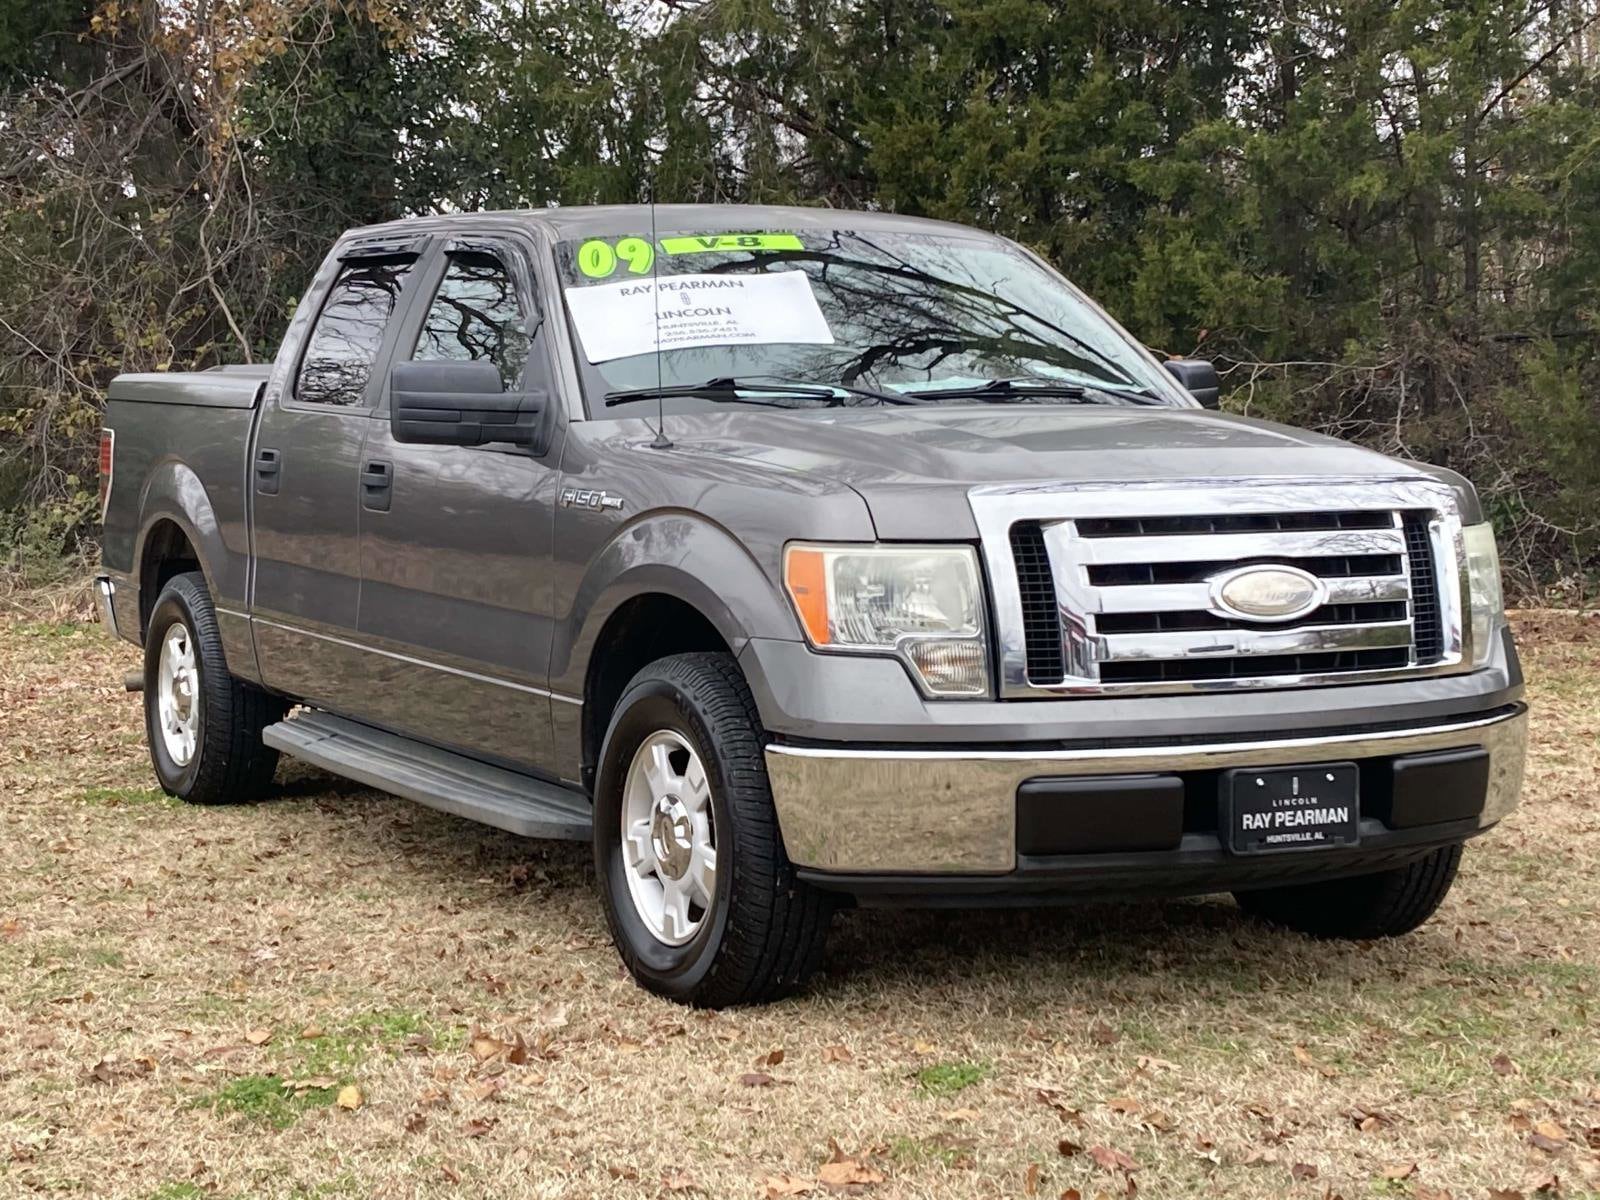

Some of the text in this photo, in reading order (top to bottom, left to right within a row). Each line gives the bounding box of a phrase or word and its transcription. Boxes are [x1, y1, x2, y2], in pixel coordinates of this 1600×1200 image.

[696, 237, 762, 249] V-8
[578, 237, 655, 279] 09
[620, 280, 745, 297] RAY PEARMAN
[655, 307, 732, 320] LINCOLN
[1272, 796, 1318, 807] LINCOLN
[1242, 807, 1349, 830] RAY PEARMAN
[1314, 831, 1325, 840] AL
